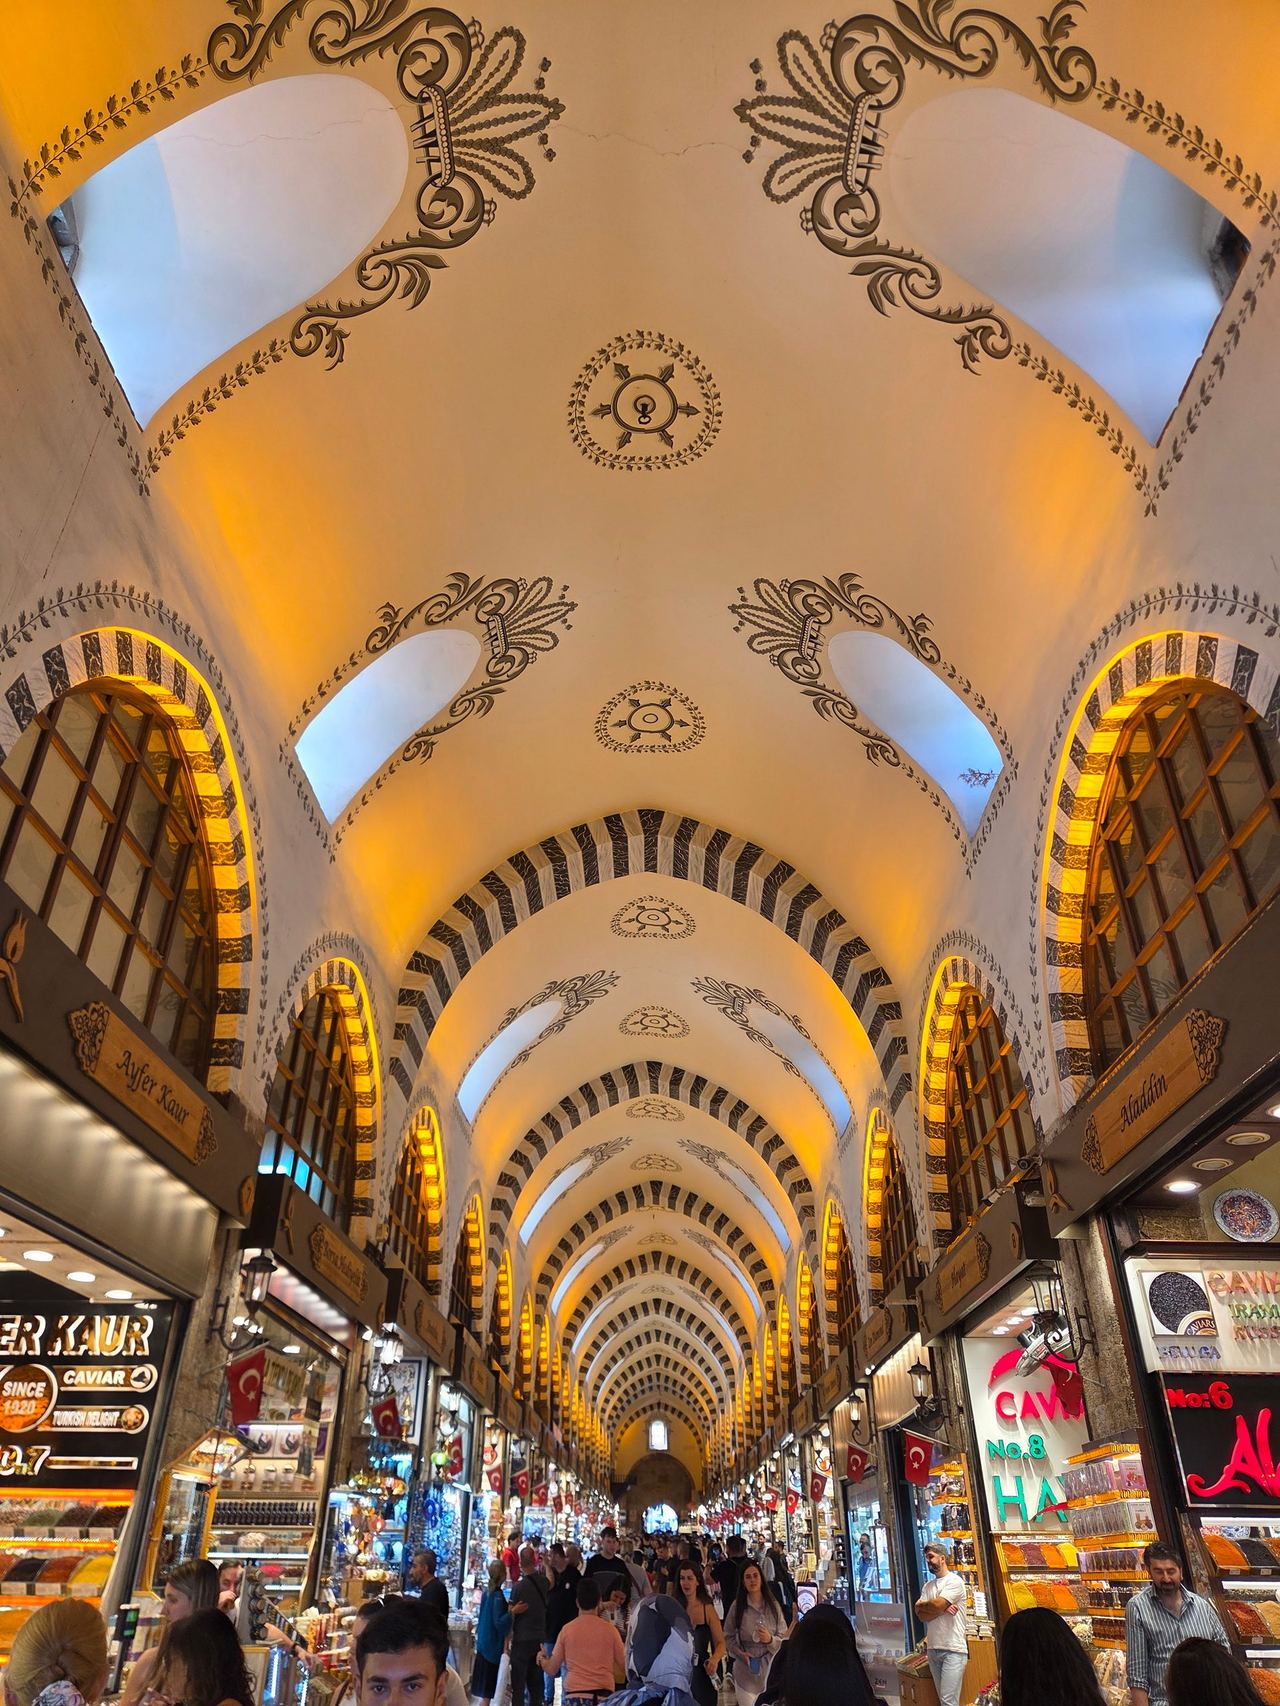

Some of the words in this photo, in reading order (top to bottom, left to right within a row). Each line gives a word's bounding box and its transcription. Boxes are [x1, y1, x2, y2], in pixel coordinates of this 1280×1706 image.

[116, 1050, 157, 1096] Ayfer
[157, 1084, 190, 1125] Kaur
[1121, 1073, 1167, 1132] Aladdin
[1011, 1233, 1017, 1248] 8
[47, 1315, 154, 1356] KAUR
[1186, 1319, 1216, 1336] CAVIARS
[2, 1381, 47, 1398] SINCE
[63, 1370, 126, 1385] CAVIAR
[3, 1400, 37, 1416] 1920
[986, 1434, 1047, 1460] No.8
[1186, 1407, 1280, 1498] Al
[993, 1475, 1069, 1523] HA
